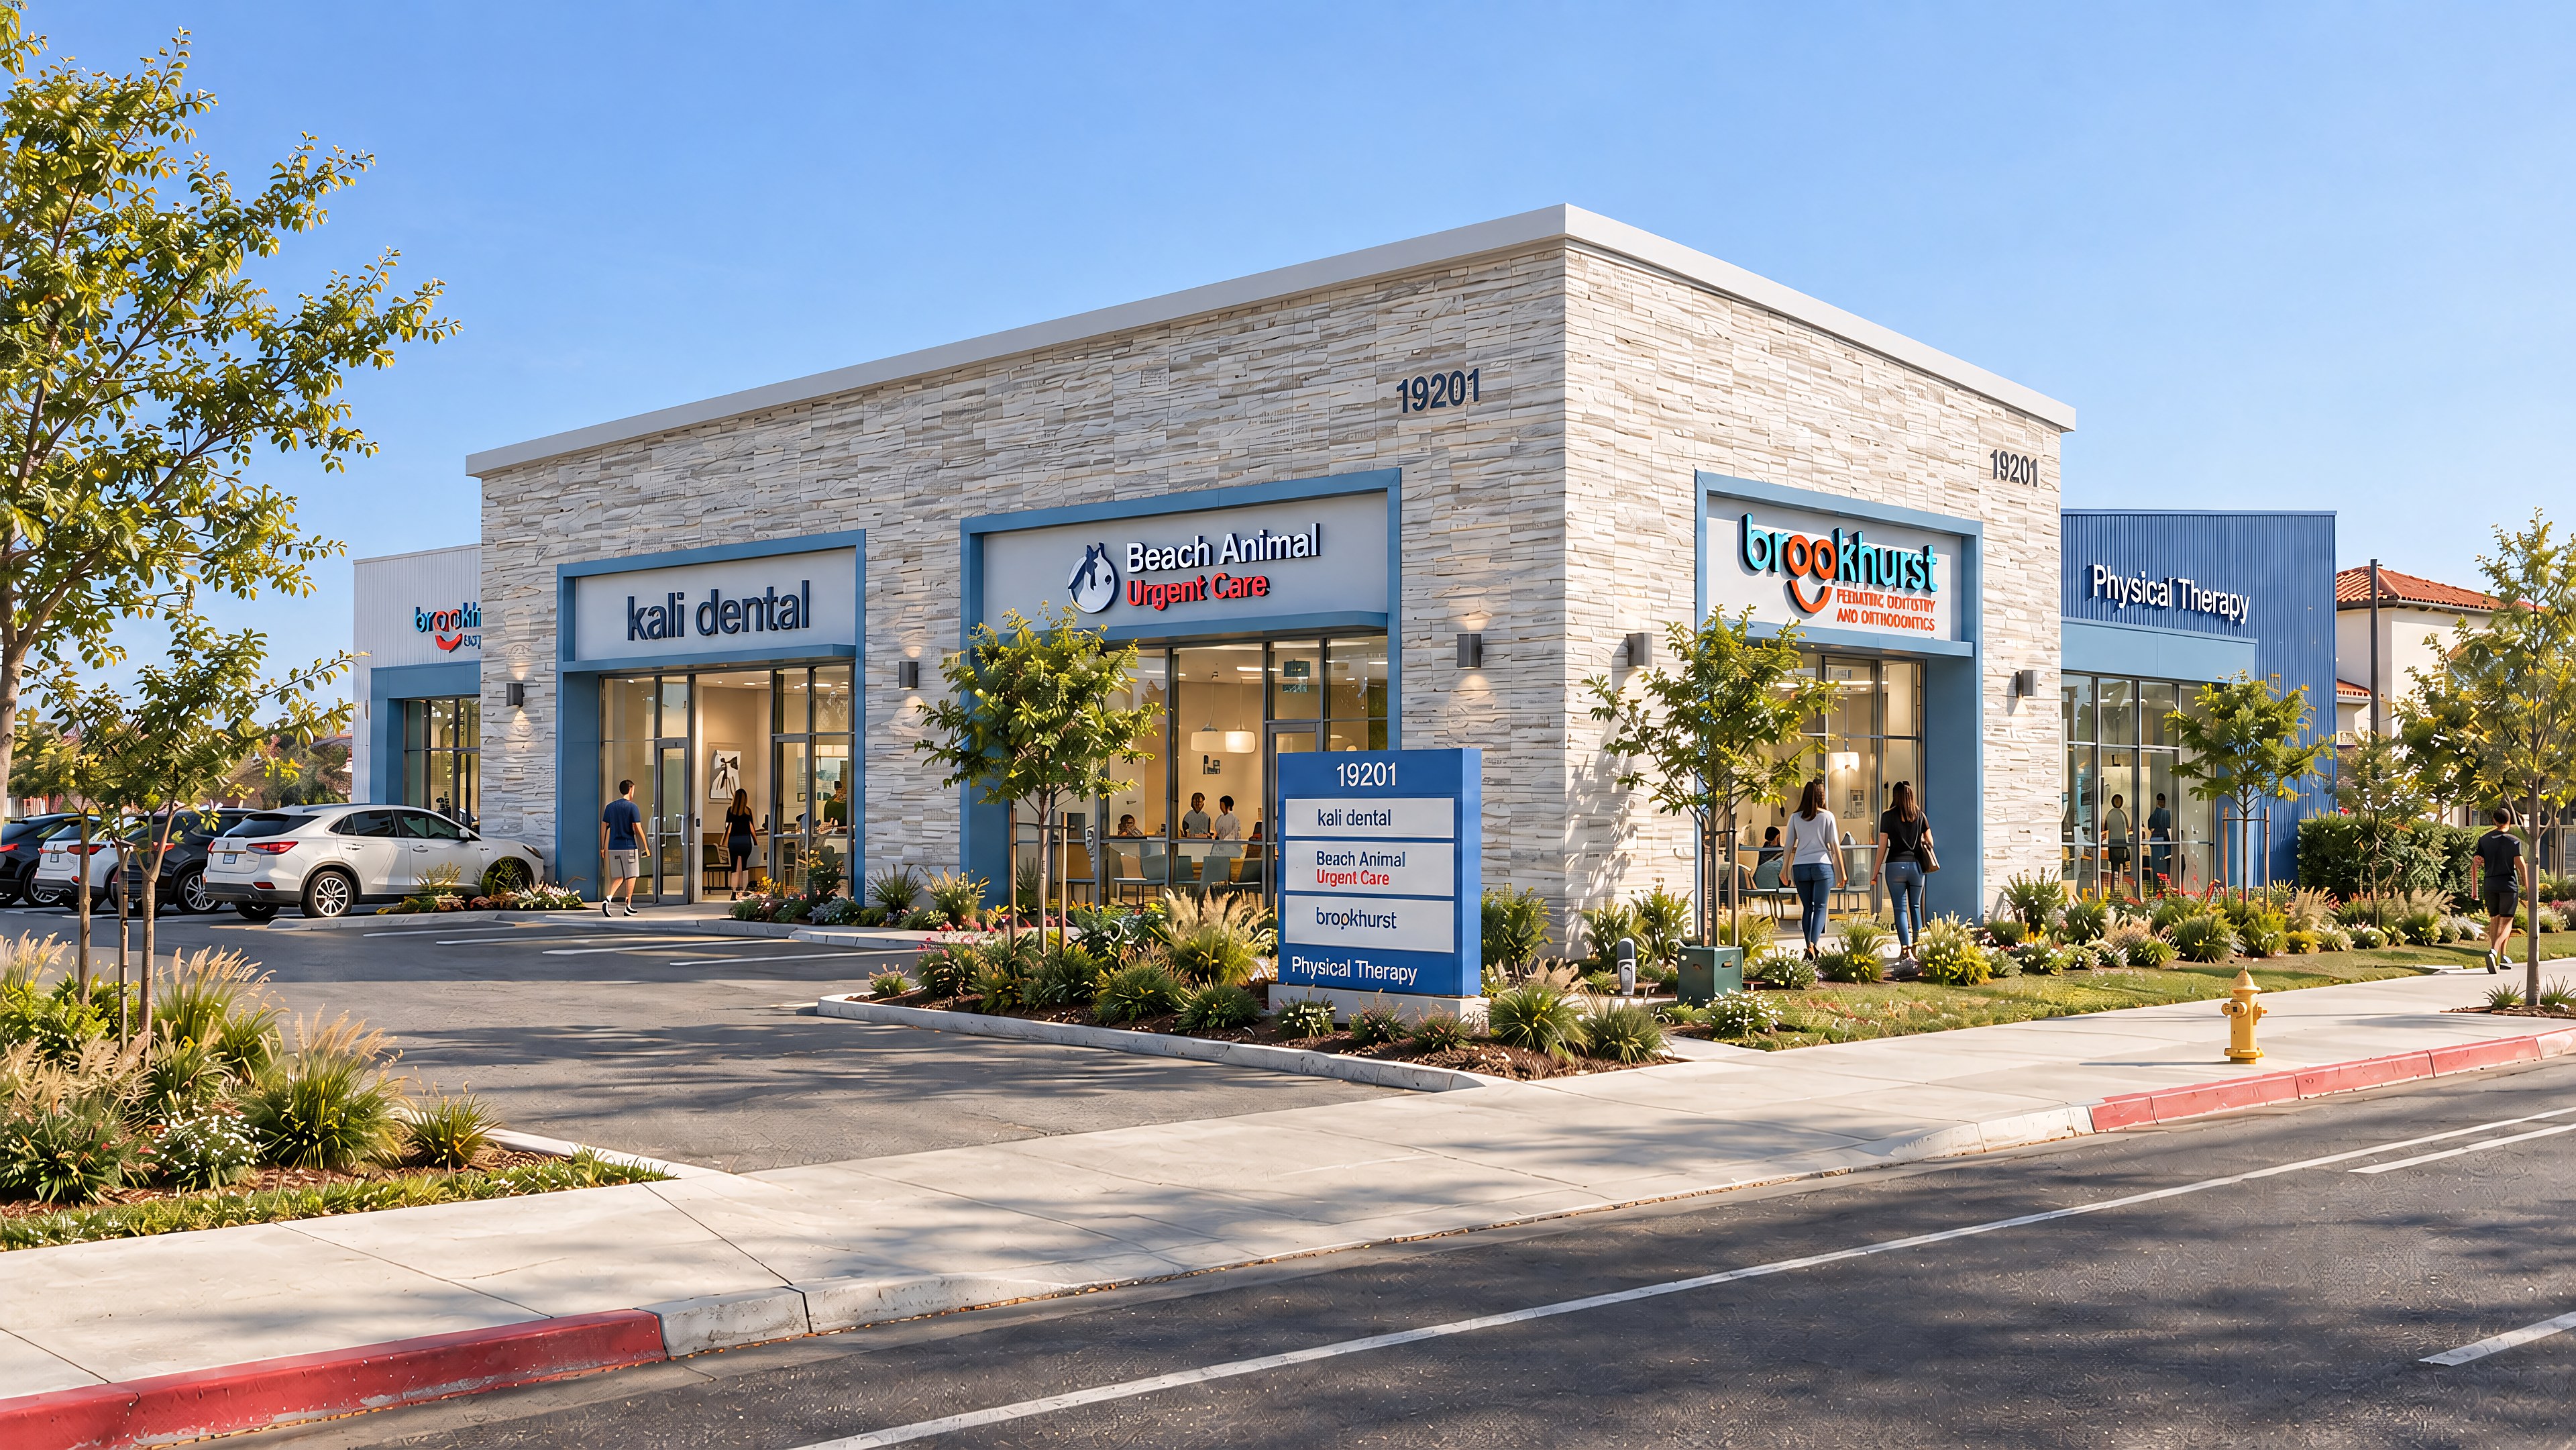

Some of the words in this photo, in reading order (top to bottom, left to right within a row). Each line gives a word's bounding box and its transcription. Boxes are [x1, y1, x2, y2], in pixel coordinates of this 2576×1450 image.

[1397, 368, 1479, 413] 19201
[1990, 449, 2037, 488] 19201
[1126, 535, 1212, 573] Beach
[1219, 523, 1321, 564] Animal
[1741, 513, 1937, 592] brookhurst
[627, 591, 684, 641] kali
[696, 580, 810, 635] dental
[1127, 574, 1207, 611] Urgent
[1211, 573, 1270, 599] Care
[2093, 564, 2173, 609] Physical
[2178, 578, 2251, 625] Therapy
[1336, 762, 1396, 787] 19201
[1318, 809, 1342, 826] kali
[1346, 809, 1391, 826] dental
[1316, 850, 1356, 866] Beach
[1359, 851, 1405, 868] Animal
[1317, 869, 1357, 887] Urgent
[1360, 870, 1389, 885] Care
[1292, 956, 1350, 979] Physical
[1355, 960, 1417, 986] Therapy
